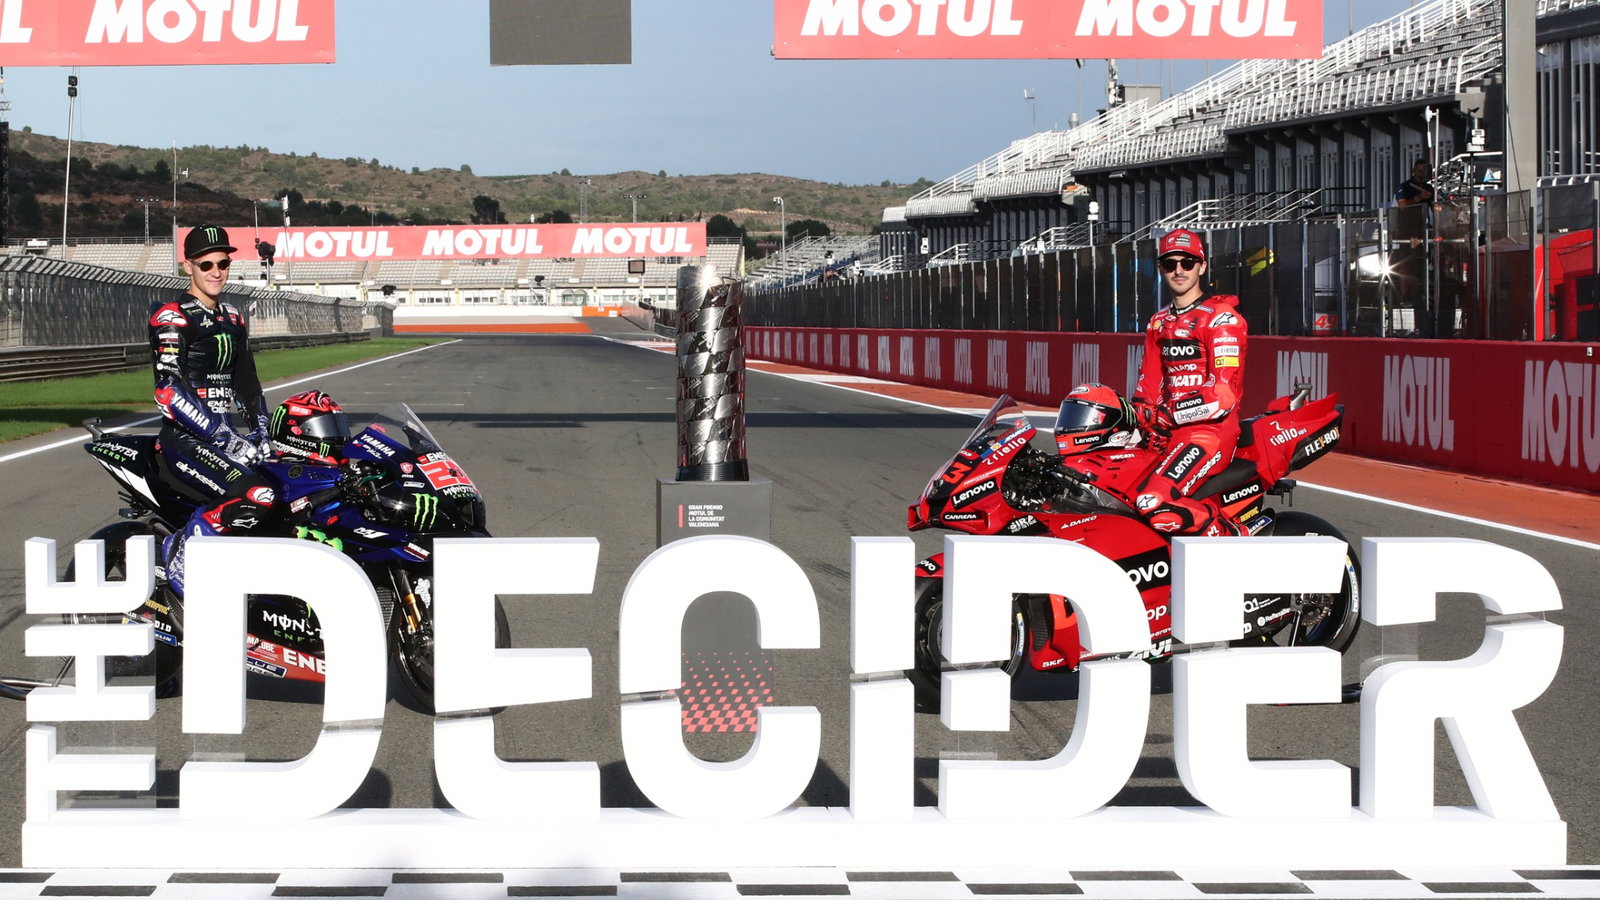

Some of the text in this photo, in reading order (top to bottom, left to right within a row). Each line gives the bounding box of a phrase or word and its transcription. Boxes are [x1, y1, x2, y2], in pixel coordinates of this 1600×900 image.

[85, 0, 309, 43] MOTUL
[800, 0, 1023, 37] MOTUL
[1075, 0, 1298, 37] MOTUL
[275, 231, 394, 257] MOTUL
[422, 229, 543, 256] MOTUL
[572, 227, 692, 254] MOTUL
[1025, 341, 1050, 395] MOTUL
[170, 393, 211, 430] YAMAHA
[1176, 398, 1202, 410] Lenovo
[1177, 407, 1210, 421] UnipolSai
[1382, 354, 1455, 451] MOTUL
[286, 435, 318, 449] MONSTER
[360, 433, 396, 457] YAMAHA
[992, 437, 1027, 461] riello
[1074, 436, 1100, 445] Lenovo
[1269, 428, 1299, 447] riello
[1304, 426, 1340, 457] FLEX-BOX
[91, 446, 127, 463] ENERGY
[194, 445, 229, 471] MONSTER
[1167, 446, 1200, 479] Lenovo
[952, 480, 995, 505] Lenovo
[1222, 484, 1260, 503] Lenovo
[25, 535, 155, 822] THE
[179, 535, 1564, 822] DECIDER
